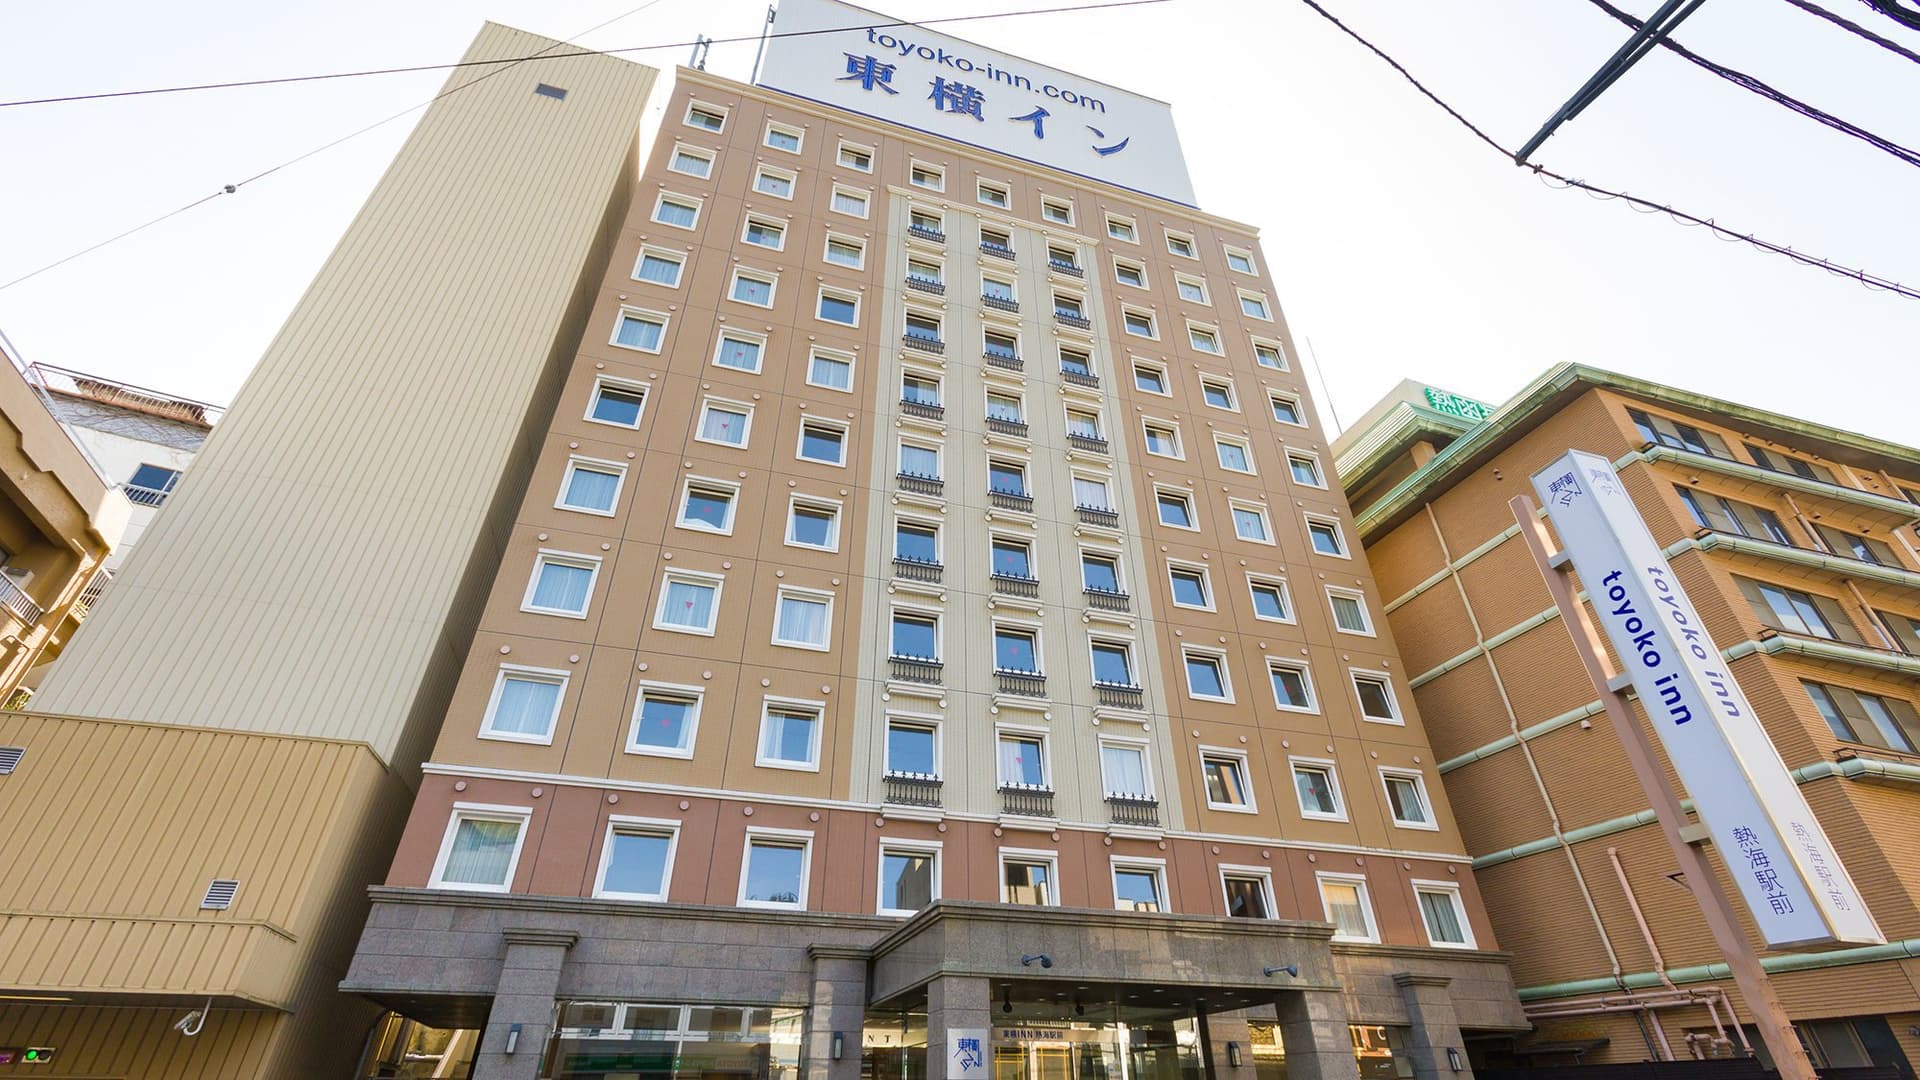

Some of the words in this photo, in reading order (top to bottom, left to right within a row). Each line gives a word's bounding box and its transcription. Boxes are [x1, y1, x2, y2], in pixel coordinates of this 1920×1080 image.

[836, 52, 1130, 158] 東横イン
[867, 27, 1106, 114] toyoko-inn.com
[1602, 569, 1661, 667] toyoko
[1655, 673, 1693, 726] inn
[1647, 566, 1707, 660] toyoko
[1705, 670, 1740, 717] inn
[1732, 824, 1795, 915] 熱海駅前
